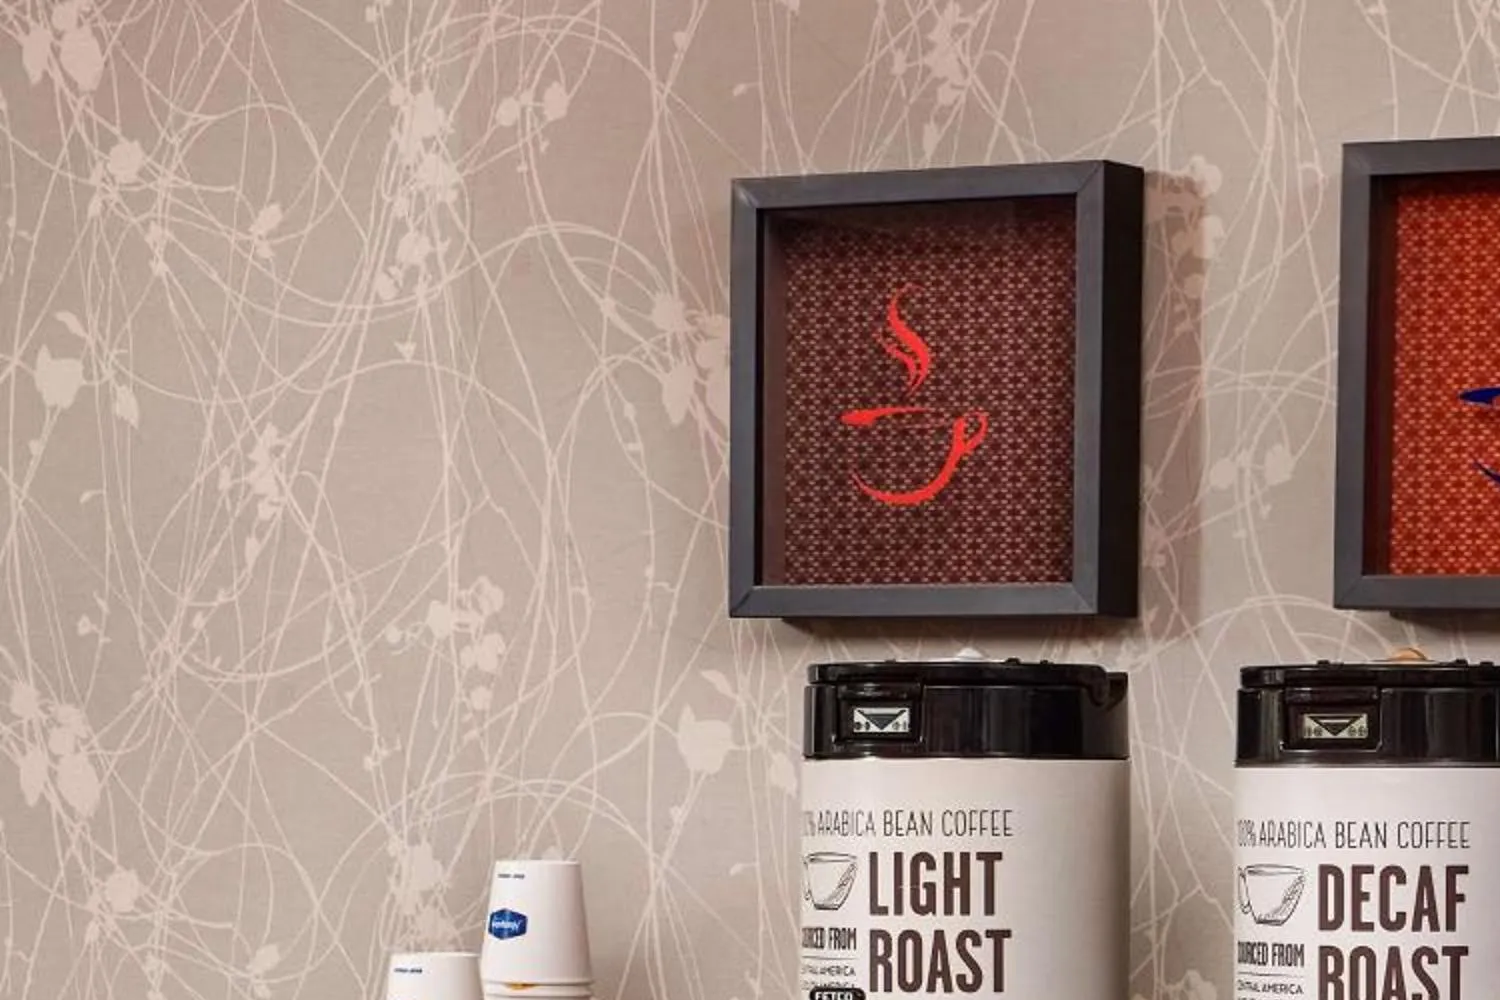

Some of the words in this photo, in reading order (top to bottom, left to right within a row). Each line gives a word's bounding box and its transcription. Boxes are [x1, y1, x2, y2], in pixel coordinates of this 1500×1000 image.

[818, 809, 876, 837] ARABICA
[882, 809, 933, 837] BEAN
[941, 809, 1013, 837] COFFEE
[1260, 820, 1327, 848] ARABICA
[1335, 821, 1388, 848] BEAN
[1397, 821, 1471, 848] COFFEE
[868, 851, 1003, 917] LIGHT
[1317, 863, 1470, 933] DECAF
[868, 929, 1012, 994] ROAST
[1271, 943, 1305, 968] FROM
